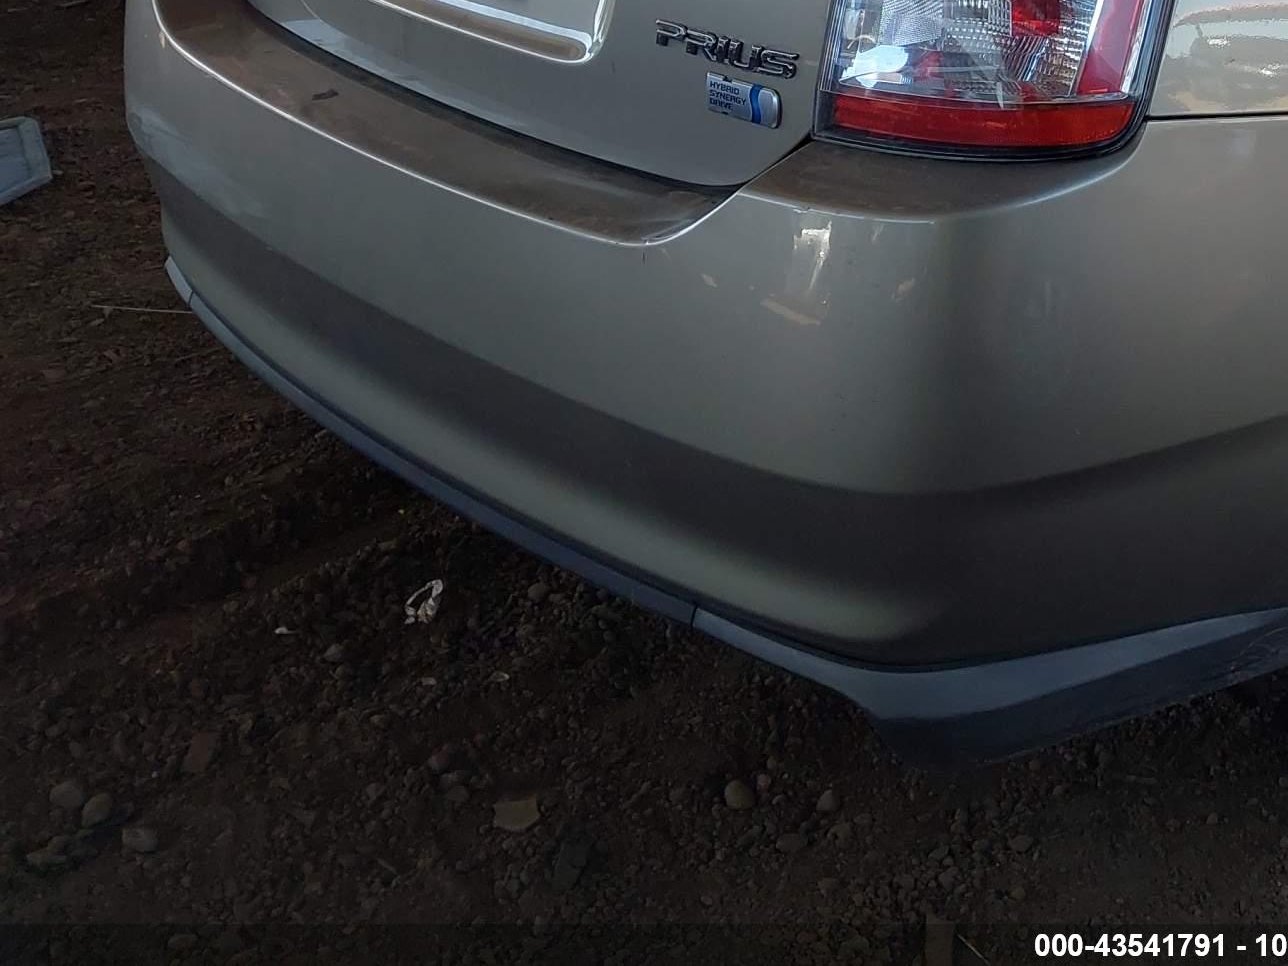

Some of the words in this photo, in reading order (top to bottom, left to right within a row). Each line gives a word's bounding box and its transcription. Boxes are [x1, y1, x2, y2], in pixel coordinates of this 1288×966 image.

[655, 18, 800, 79] PRIUS
[709, 80, 740, 96] HYBRID
[709, 89, 747, 106] SYNERGY
[709, 97, 734, 111] DRIVE
